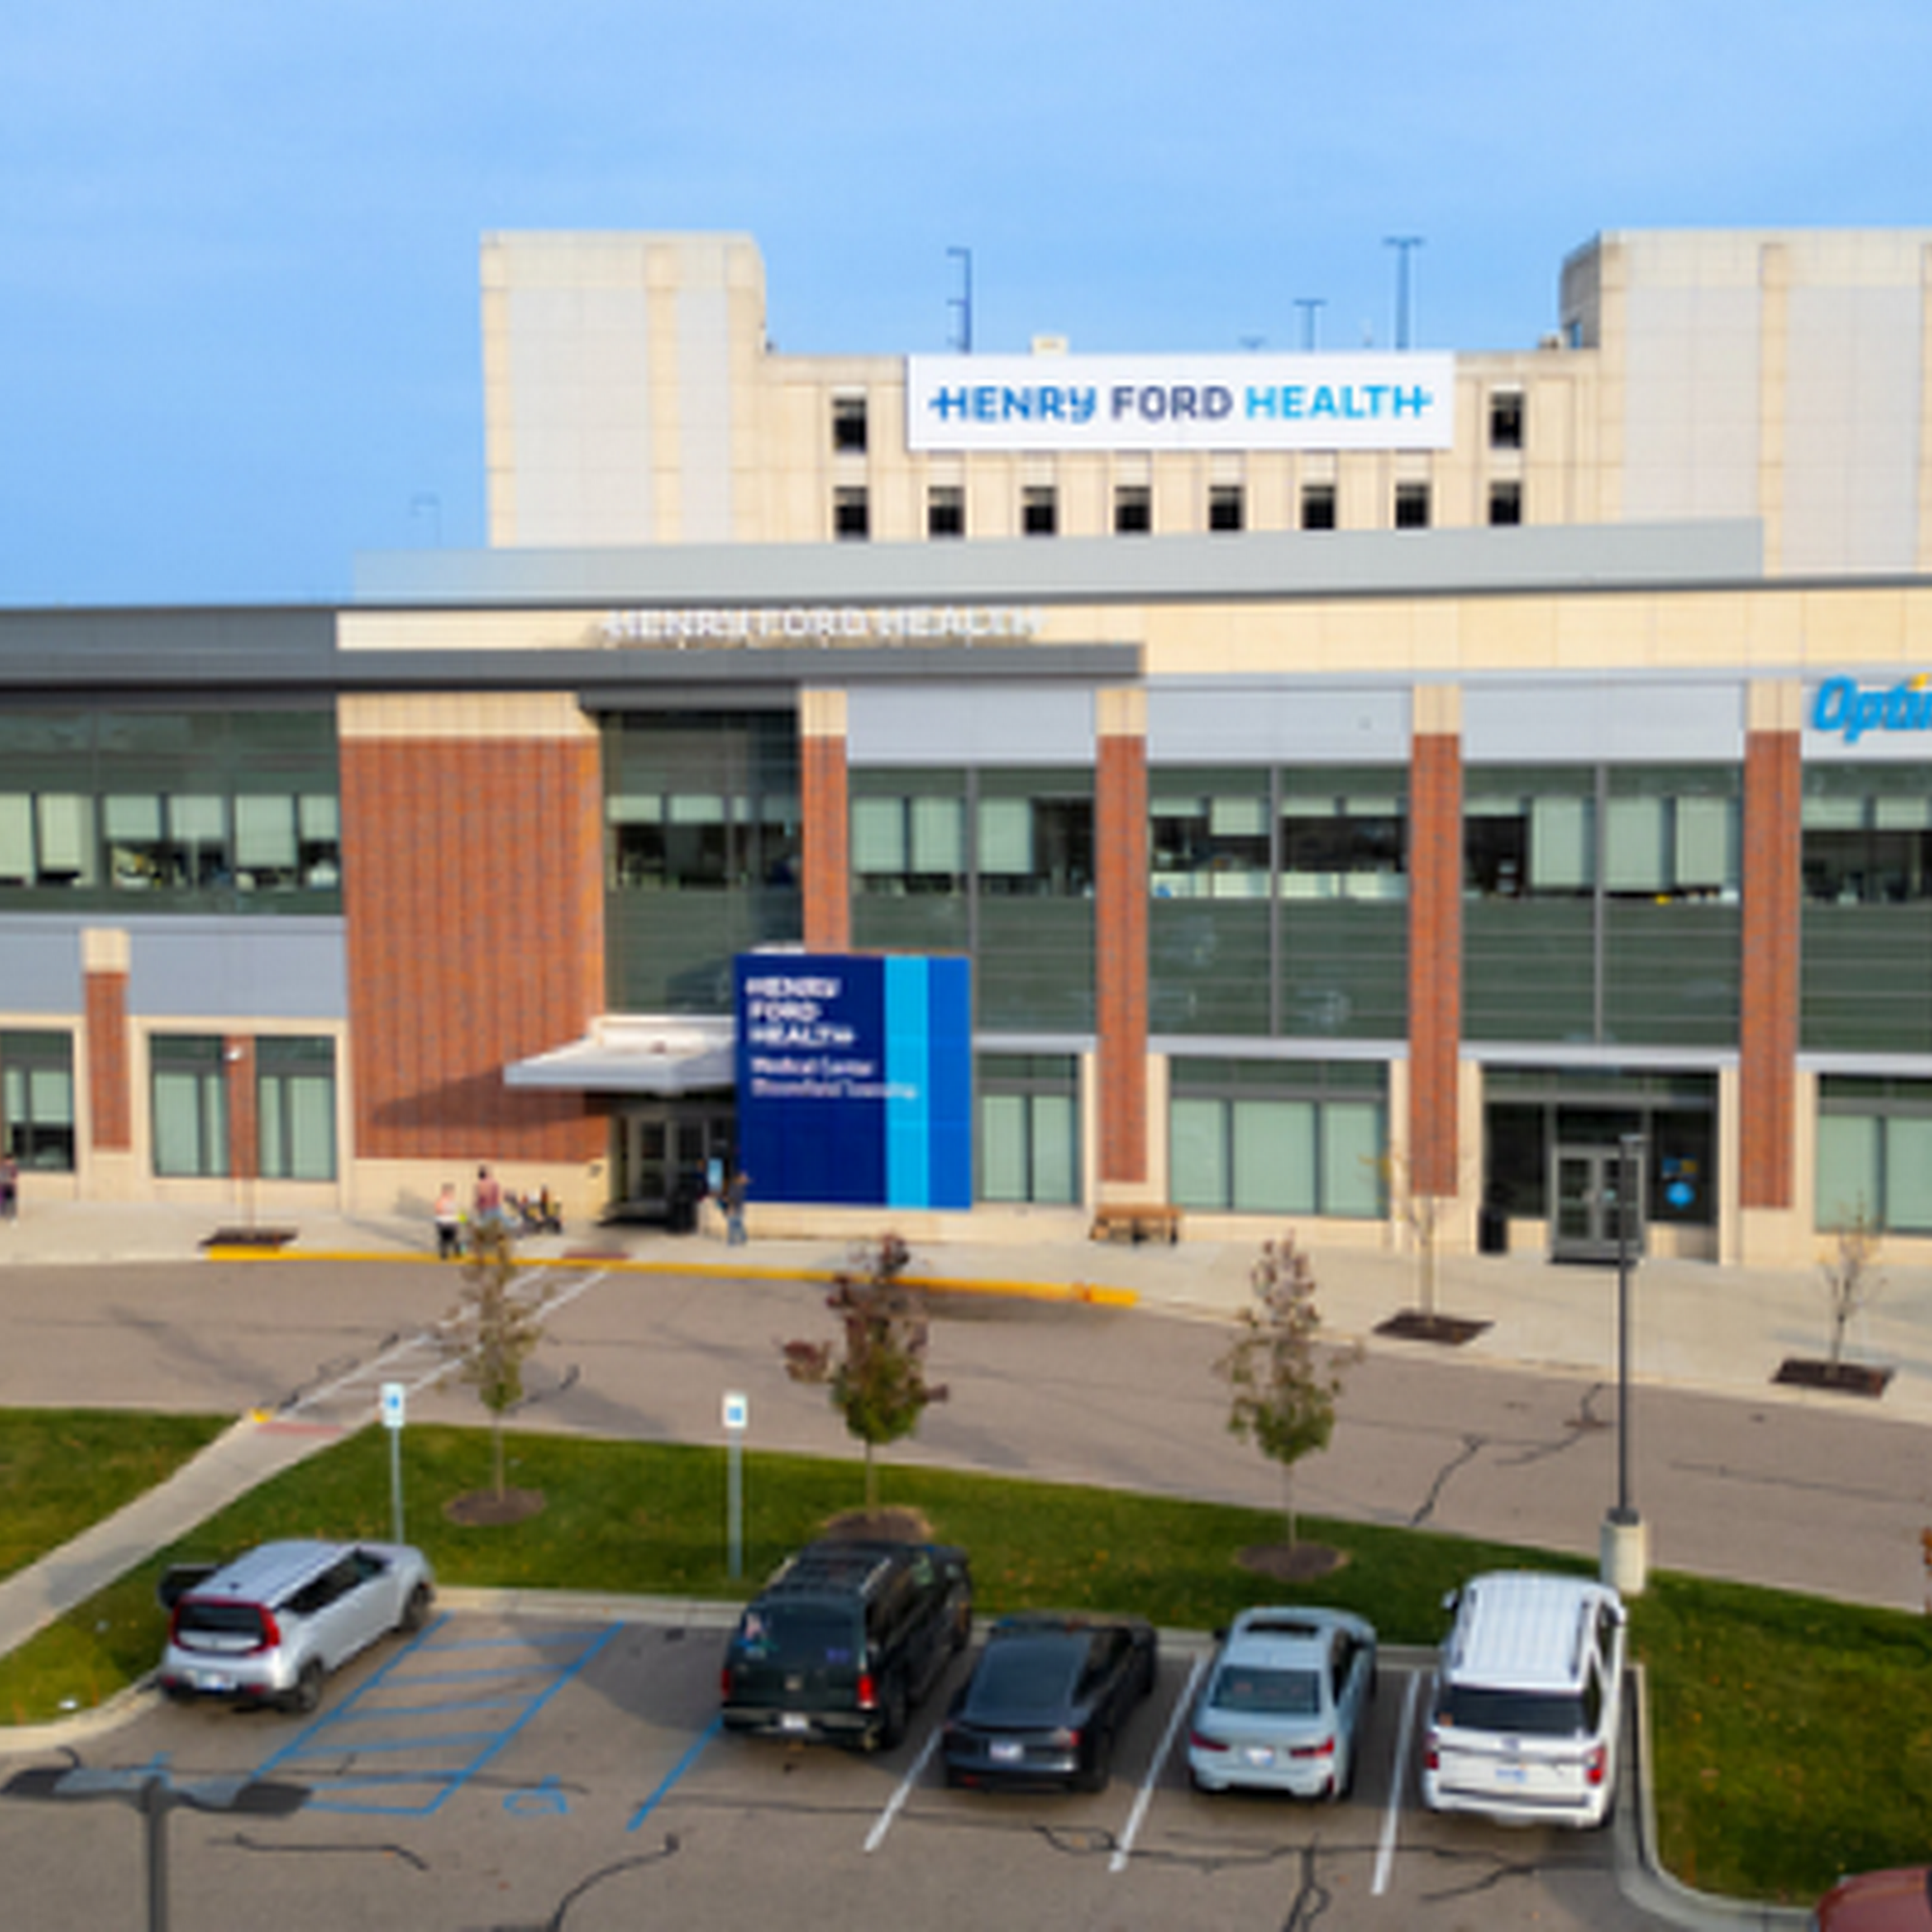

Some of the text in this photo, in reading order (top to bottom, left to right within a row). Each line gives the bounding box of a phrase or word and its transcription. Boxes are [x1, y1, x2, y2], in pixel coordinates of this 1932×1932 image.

[929, 384, 1097, 424] HENRY
[1110, 384, 1234, 421] FORD
[753, 607, 868, 637] FORD
[748, 1000, 822, 1021] FORD
